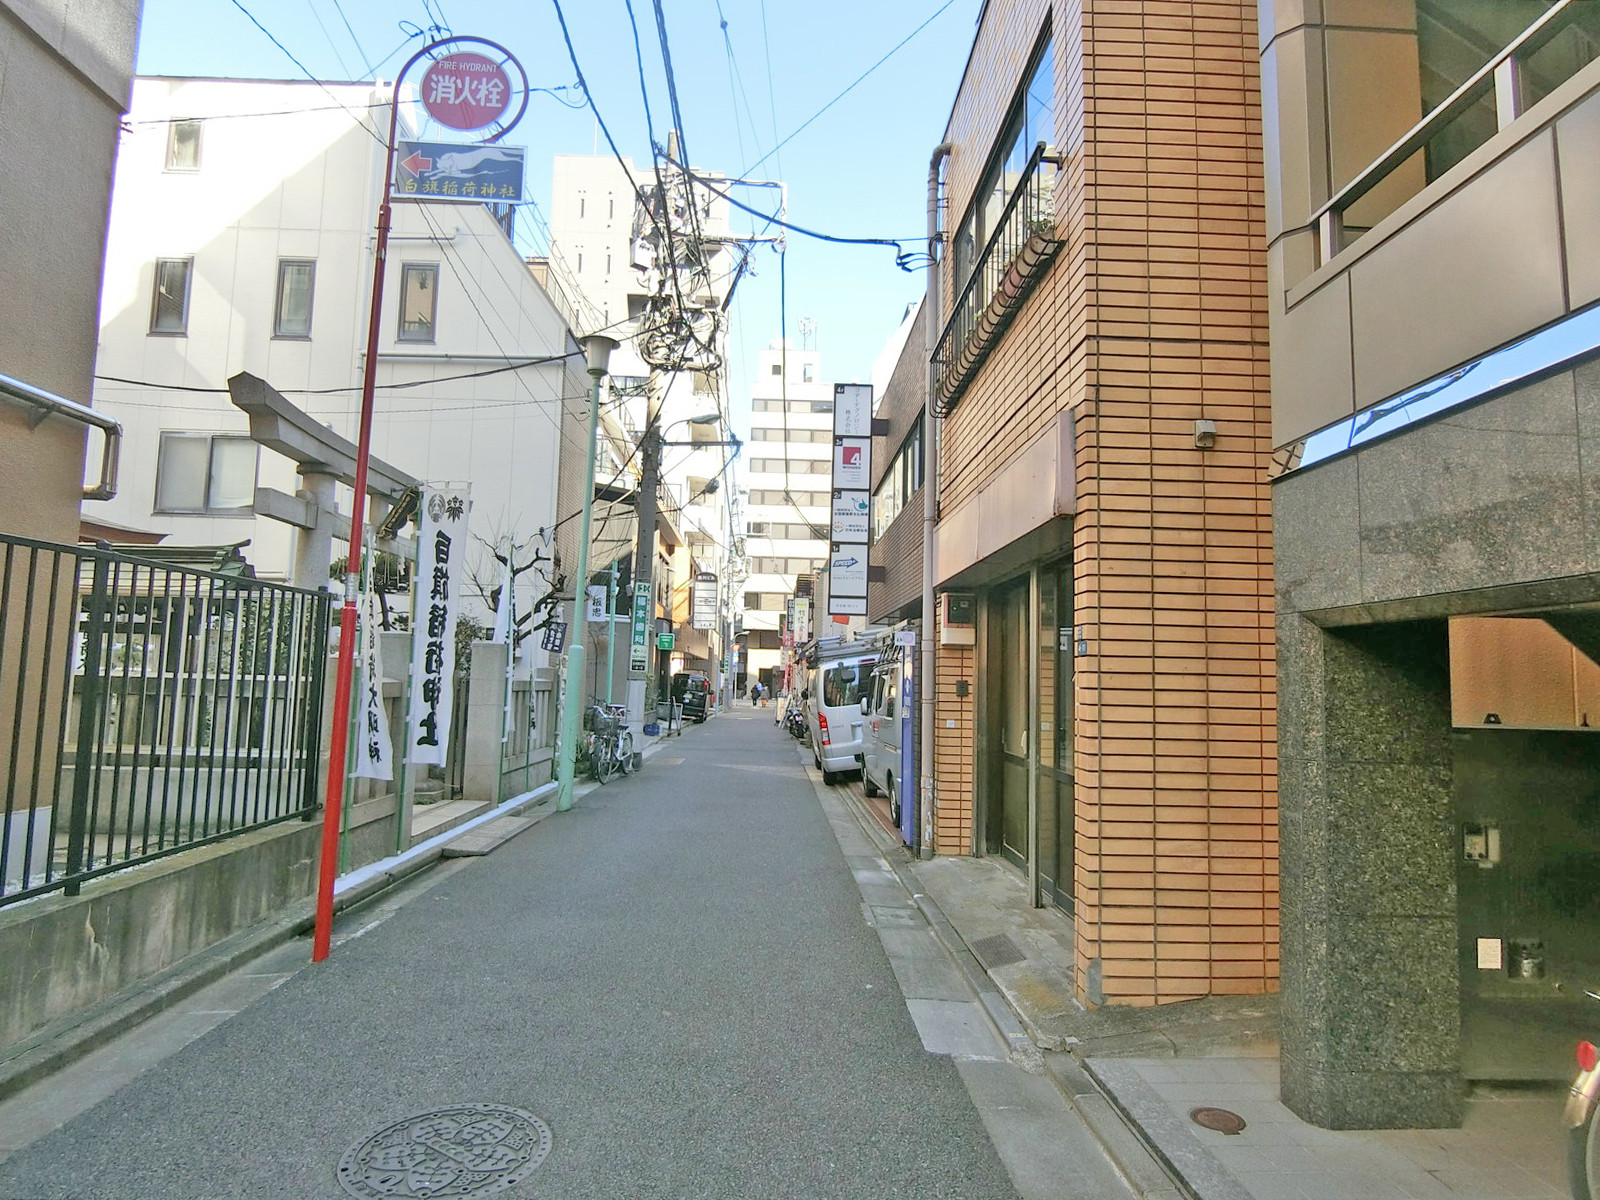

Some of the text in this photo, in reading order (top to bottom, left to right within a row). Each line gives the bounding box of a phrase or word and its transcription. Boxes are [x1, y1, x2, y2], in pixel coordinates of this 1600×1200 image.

[438, 60, 497, 73] FIRE HYDRANT
[429, 74, 504, 108] 消火栓
[404, 179, 516, 198] 白旗稲荷神社
